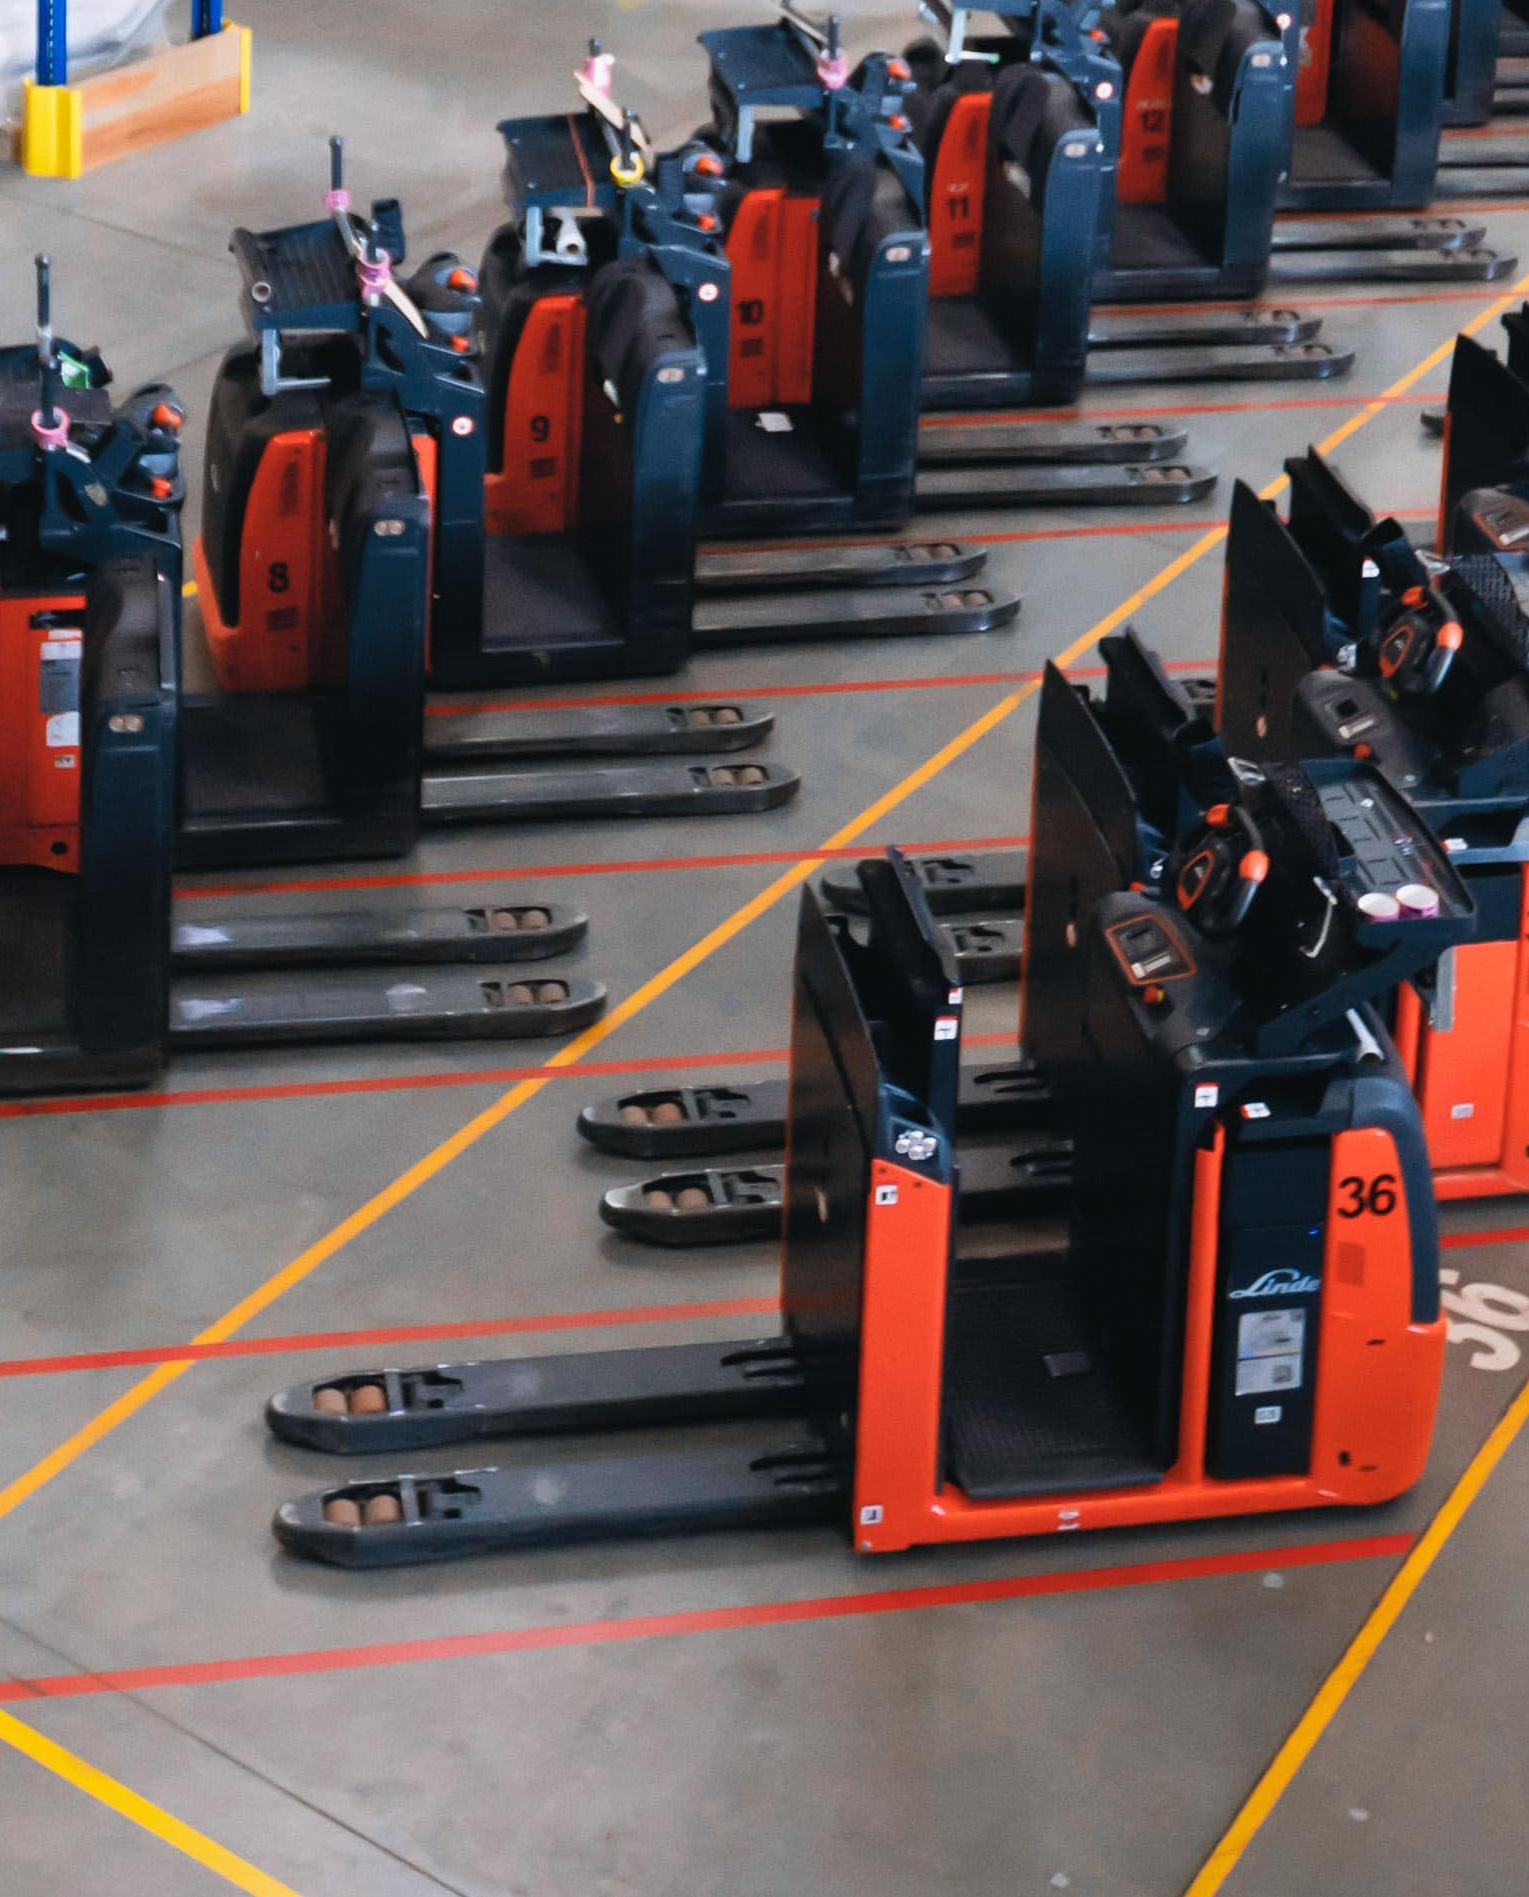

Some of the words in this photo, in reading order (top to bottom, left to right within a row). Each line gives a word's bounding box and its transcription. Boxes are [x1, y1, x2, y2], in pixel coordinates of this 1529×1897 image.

[947, 196, 970, 220] 11
[737, 299, 764, 325] 10
[530, 414, 551, 443] 9
[268, 561, 290, 593] 8
[1338, 1174, 1396, 1218] 36
[1228, 1267, 1321, 1299] Linde
